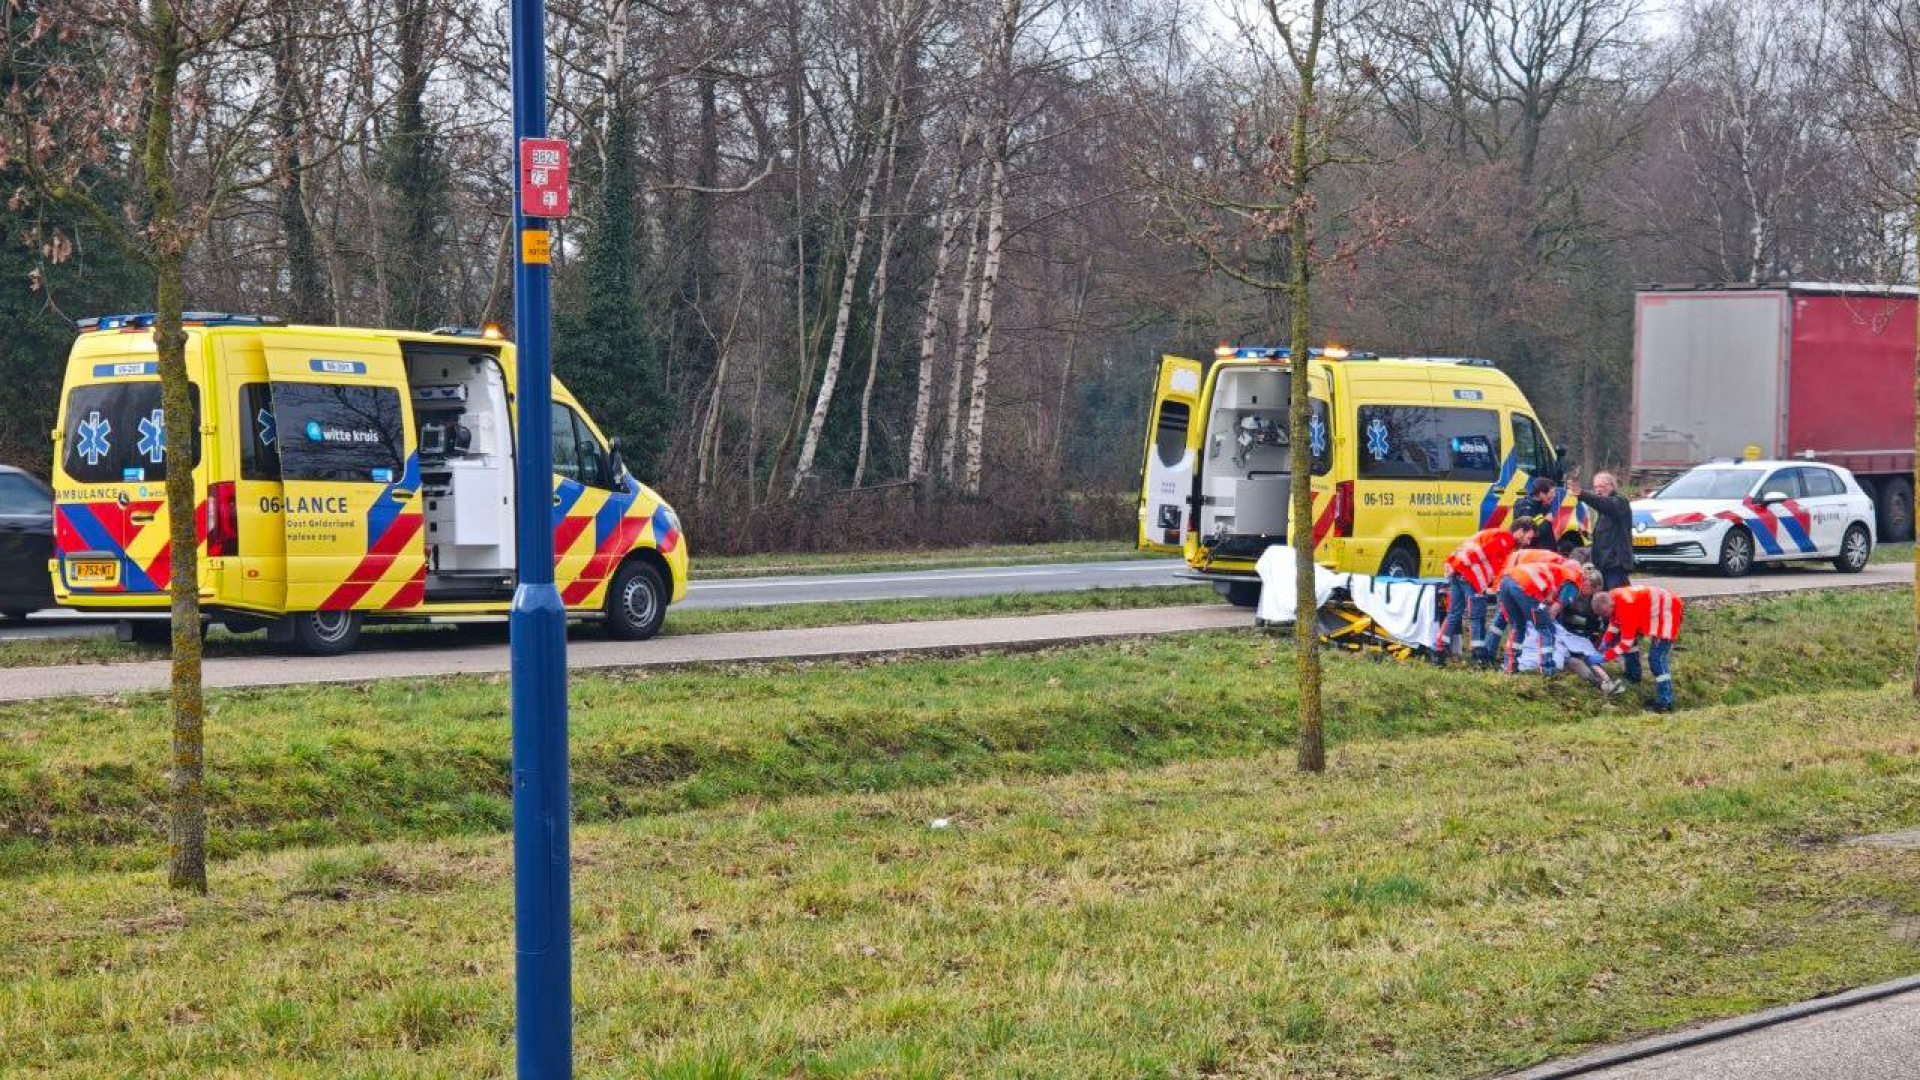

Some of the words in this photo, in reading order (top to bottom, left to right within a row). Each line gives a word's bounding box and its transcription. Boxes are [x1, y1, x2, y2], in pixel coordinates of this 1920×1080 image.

[323, 427, 351, 442] witte
[352, 428, 379, 442] kruis
[55, 487, 118, 500] AMBULANCE
[1363, 493, 1394, 506] 06-153
[1409, 493, 1472, 506] AMBULANCE
[308, 519, 355, 528] Gelderland
